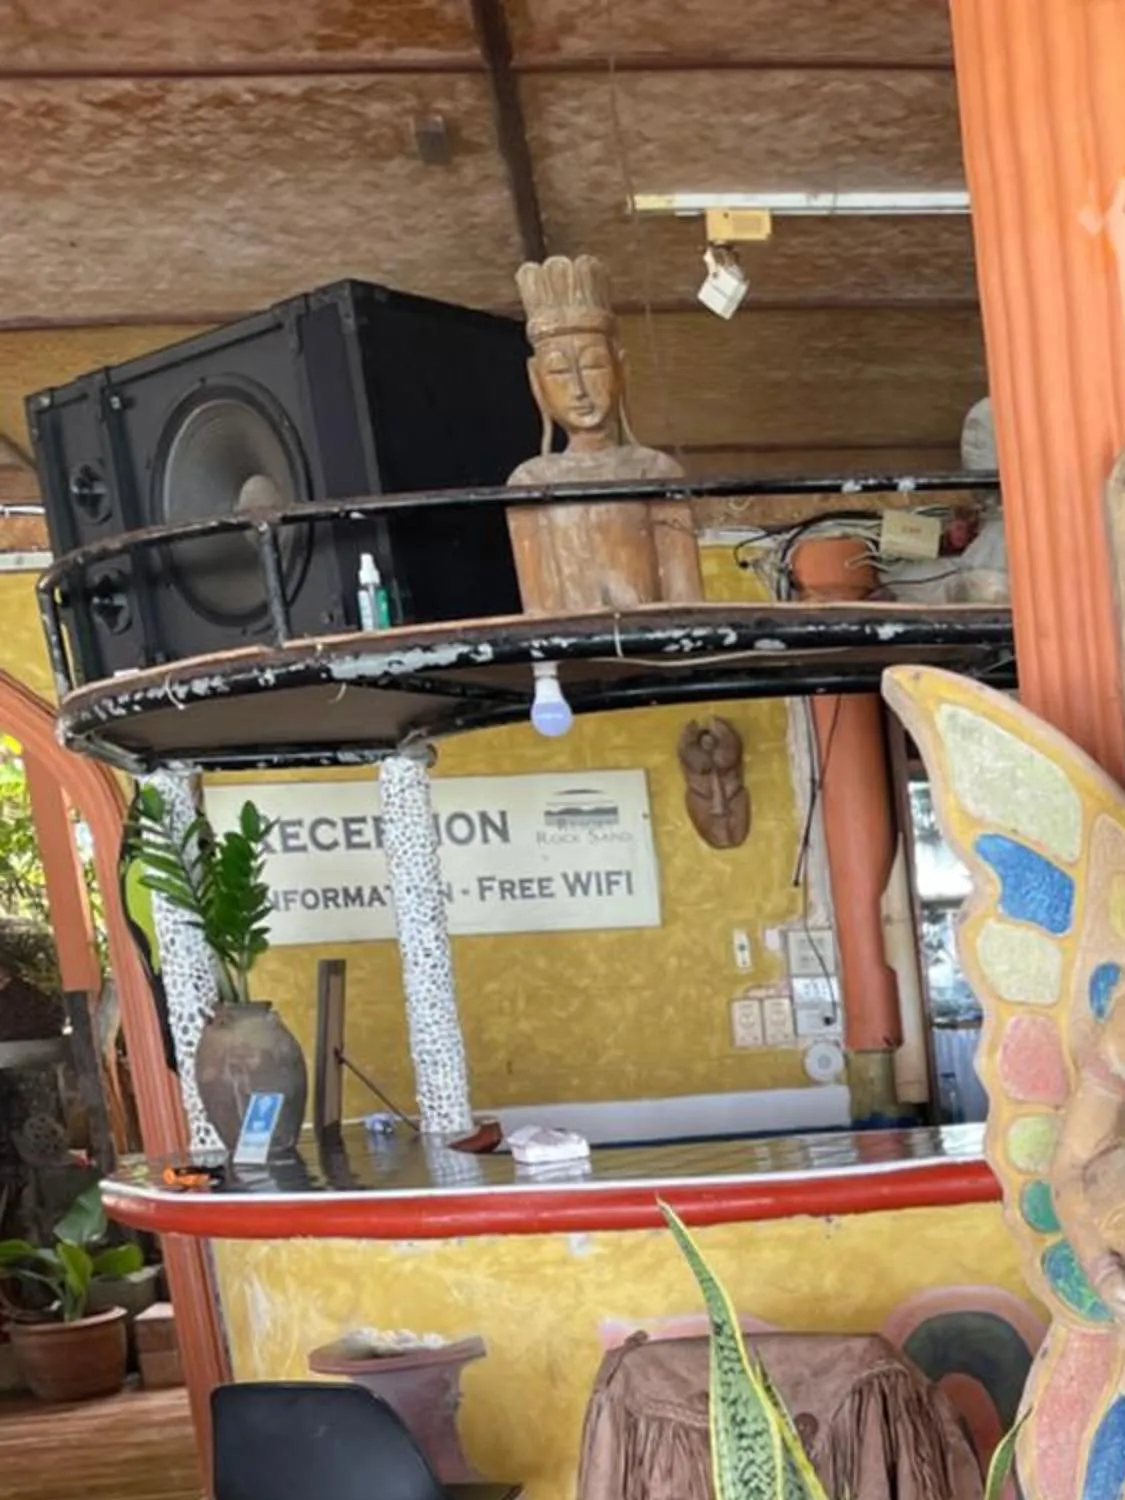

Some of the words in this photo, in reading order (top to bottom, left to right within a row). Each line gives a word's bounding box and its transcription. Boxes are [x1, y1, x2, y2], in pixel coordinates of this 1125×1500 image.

[257, 809, 511, 856] ECEION
[266, 882, 453, 914] NFORMAN
[476, 875, 556, 902] FREE
[561, 869, 634, 898] WIFI
